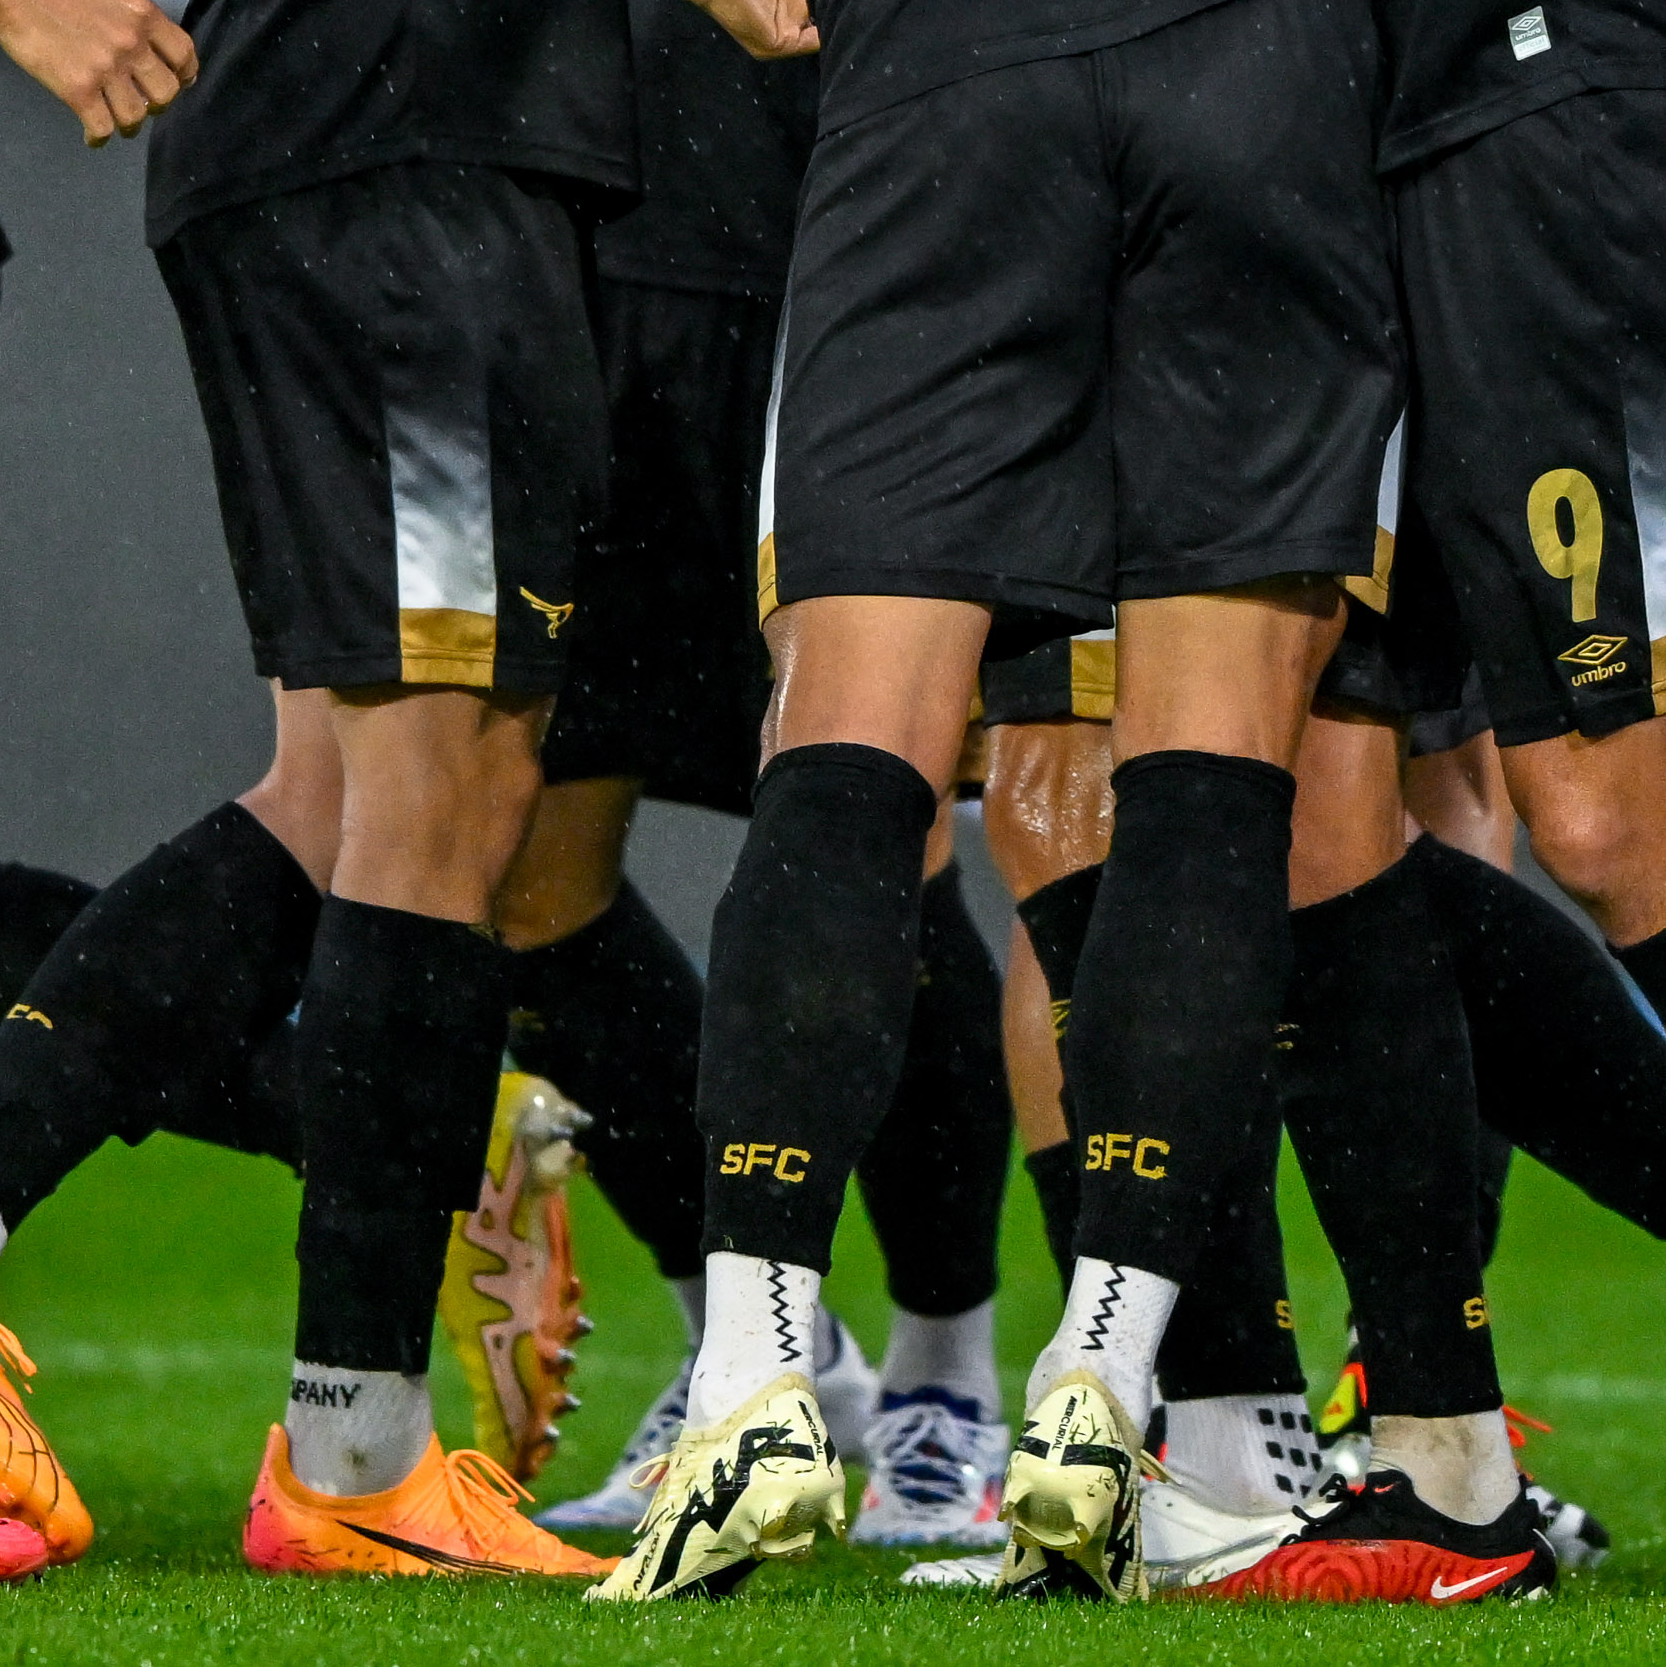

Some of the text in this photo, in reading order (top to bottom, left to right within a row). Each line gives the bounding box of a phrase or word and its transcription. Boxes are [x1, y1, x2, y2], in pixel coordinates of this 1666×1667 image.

[1527, 468, 1604, 623] 9
[1572, 661, 1628, 687] umbro
[719, 1143, 812, 1183] SFC
[1085, 1133, 1170, 1180] SFC
